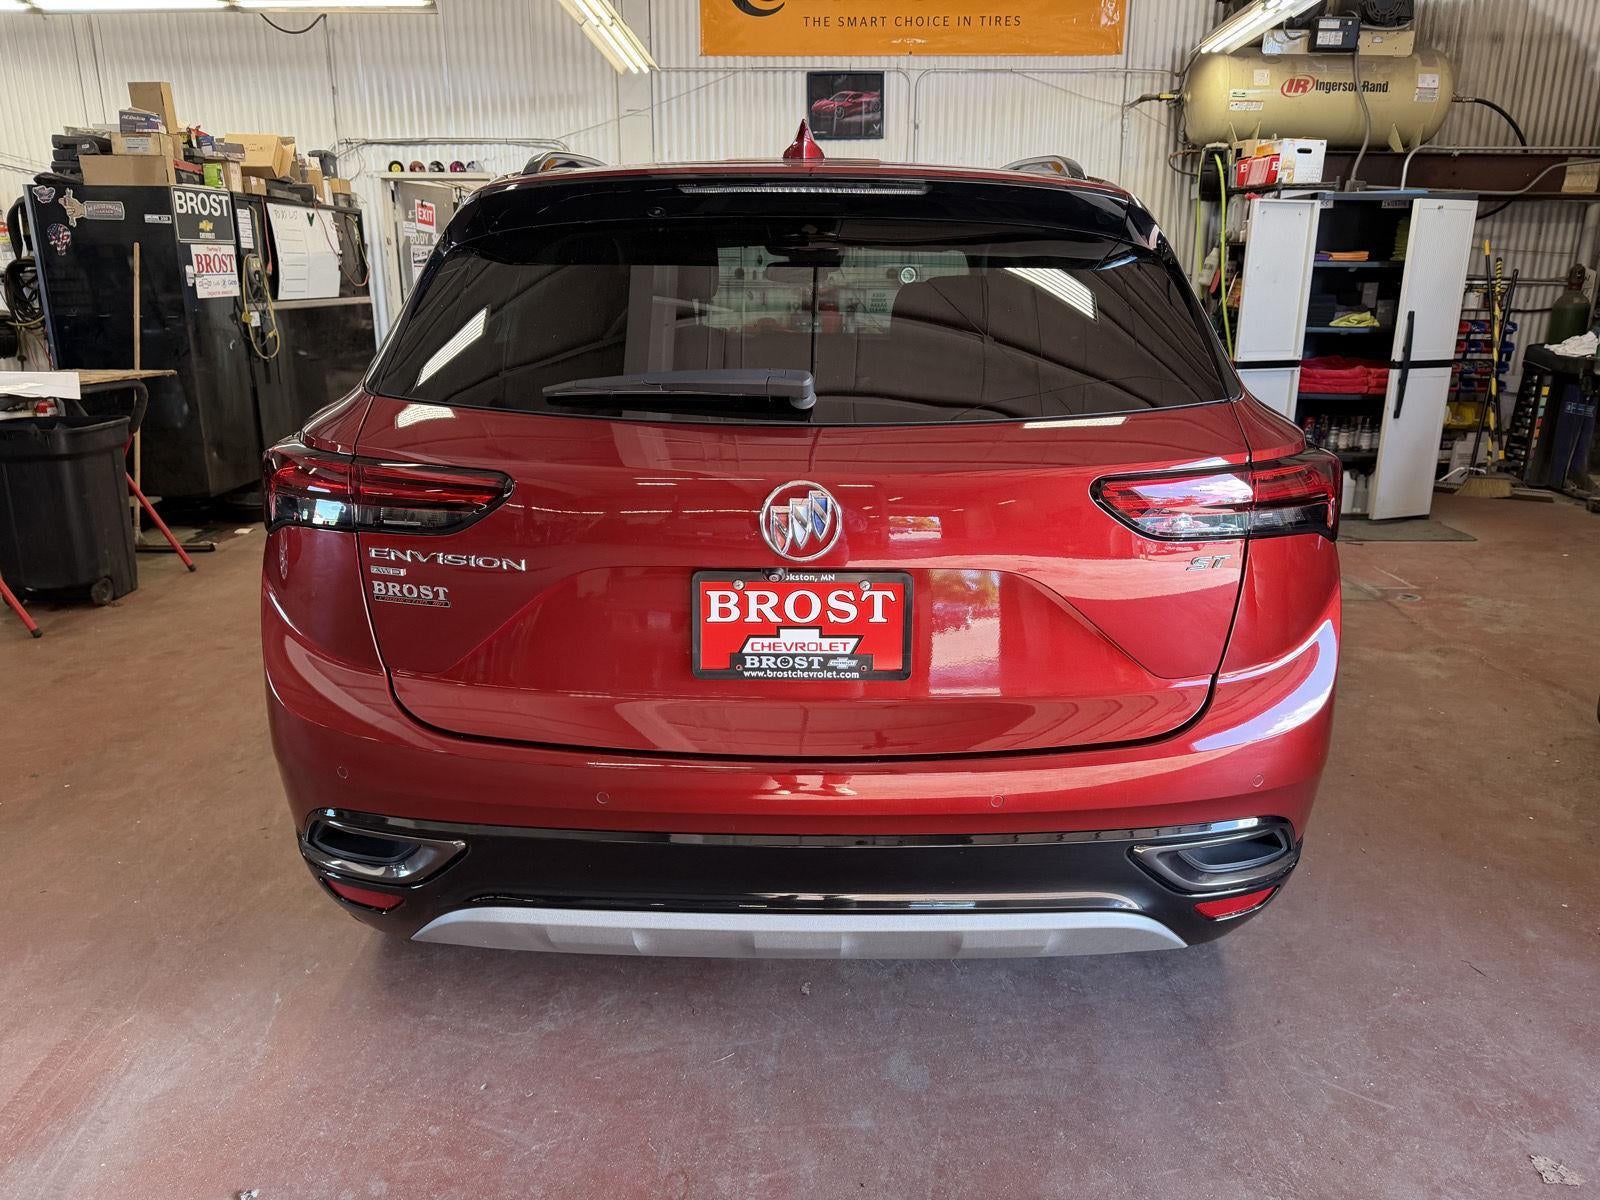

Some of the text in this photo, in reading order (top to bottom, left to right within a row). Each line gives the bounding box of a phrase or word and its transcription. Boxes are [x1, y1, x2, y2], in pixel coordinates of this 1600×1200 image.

[803, 15, 1022, 27] THE SMART CHOICE IN TIRES
[1286, 79, 1310, 94] IR
[174, 191, 229, 217] BROST
[418, 209, 433, 222] EXIT
[194, 253, 235, 274] BROST
[368, 547, 526, 572] ENVISION
[1185, 554, 1232, 572] ST
[370, 565, 406, 576] AWD
[820, 574, 836, 582] MN
[371, 580, 449, 601] BROST
[705, 589, 896, 624] BROST
[750, 641, 851, 653] CHEVROLET
[744, 655, 824, 669] BROST
[743, 670, 860, 680] www.brostchevrolet.com
